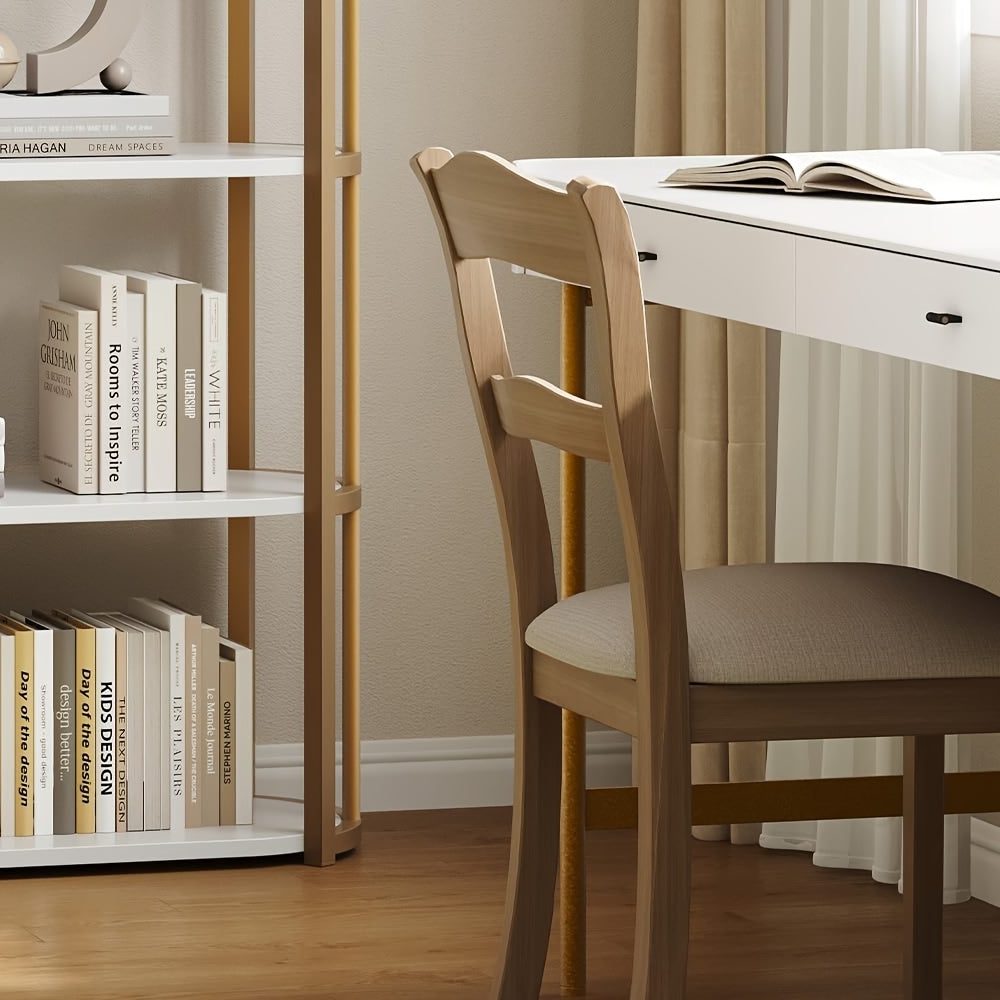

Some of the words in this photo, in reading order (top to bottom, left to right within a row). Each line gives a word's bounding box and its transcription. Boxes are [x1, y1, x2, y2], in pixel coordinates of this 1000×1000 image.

[23, 143, 66, 153] HAGAN
[89, 144, 123, 152] DREAM
[128, 143, 163, 151] SPACES
[47, 319, 69, 342] JOHN
[40, 344, 76, 372] GRISHAM
[84, 323, 93, 379] MOUNTAIN
[109, 344, 121, 398] Rooms
[156, 358, 167, 390] KATE
[84, 383, 93, 408] GRAY
[156, 393, 167, 427] MOSS
[184, 369, 195, 419] LEADERSHIP
[209, 369, 220, 429] WHITE
[84, 413, 93, 426] DE
[109, 405, 121, 421] to
[84, 429, 93, 472] SECRETO
[105, 427, 121, 482] Inspire
[84, 474, 93, 485] EL
[19, 671, 29, 700] Day
[81, 668, 91, 697] Day
[206, 688, 215, 700] Le
[20, 705, 29, 722] of
[56, 685, 72, 728] design
[82, 703, 92, 719] of
[101, 682, 113, 724] KIDS
[173, 696, 182, 722] LES
[191, 714, 197, 722] OF
[206, 702, 215, 736] Monde
[82, 723, 91, 748] the
[223, 702, 231, 739] MARINO
[20, 726, 29, 750] the
[60, 733, 72, 781] better...
[101, 729, 113, 795] DESIGN
[173, 729, 182, 796] PLAISIRS
[206, 739, 215, 774] Journal
[223, 742, 231, 784] STEPHEN
[19, 756, 29, 807] design
[80, 753, 92, 804] design
